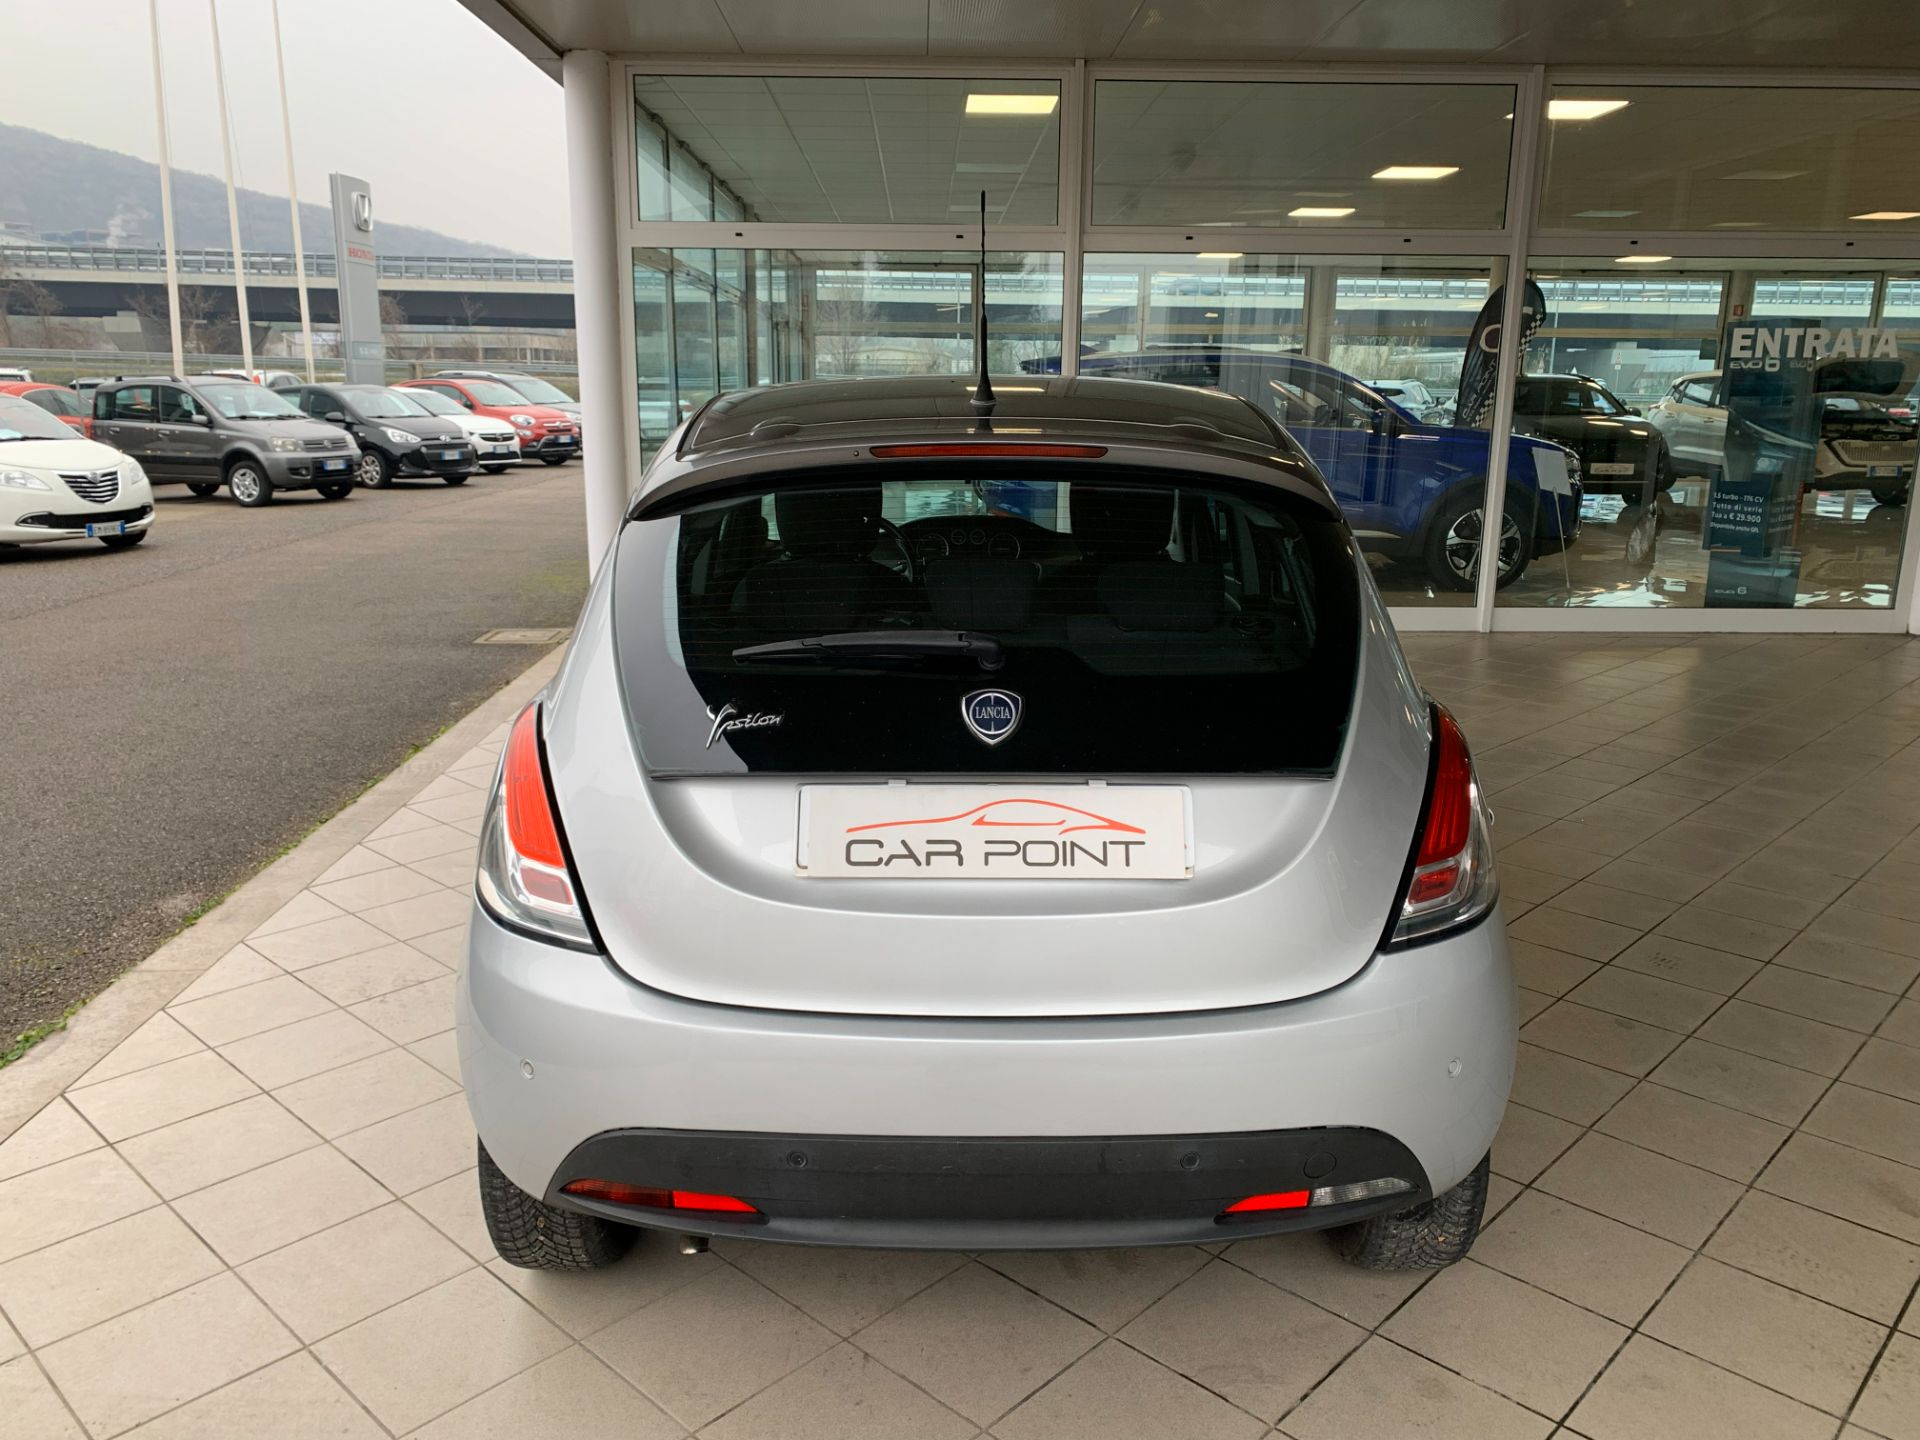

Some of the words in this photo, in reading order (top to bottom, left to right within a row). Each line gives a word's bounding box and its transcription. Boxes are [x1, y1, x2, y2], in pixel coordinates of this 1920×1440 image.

[1730, 327, 1899, 358] ENTRATA
[1729, 359, 1763, 369] EVO
[1712, 501, 1732, 510] Tutto
[1729, 512, 1735, 520] €
[1735, 513, 1762, 523] 29.900
[975, 706, 1012, 719] LANCIA
[706, 703, 785, 750] Ypsilon
[845, 839, 964, 867] CAR
[983, 840, 1147, 868] POINT
